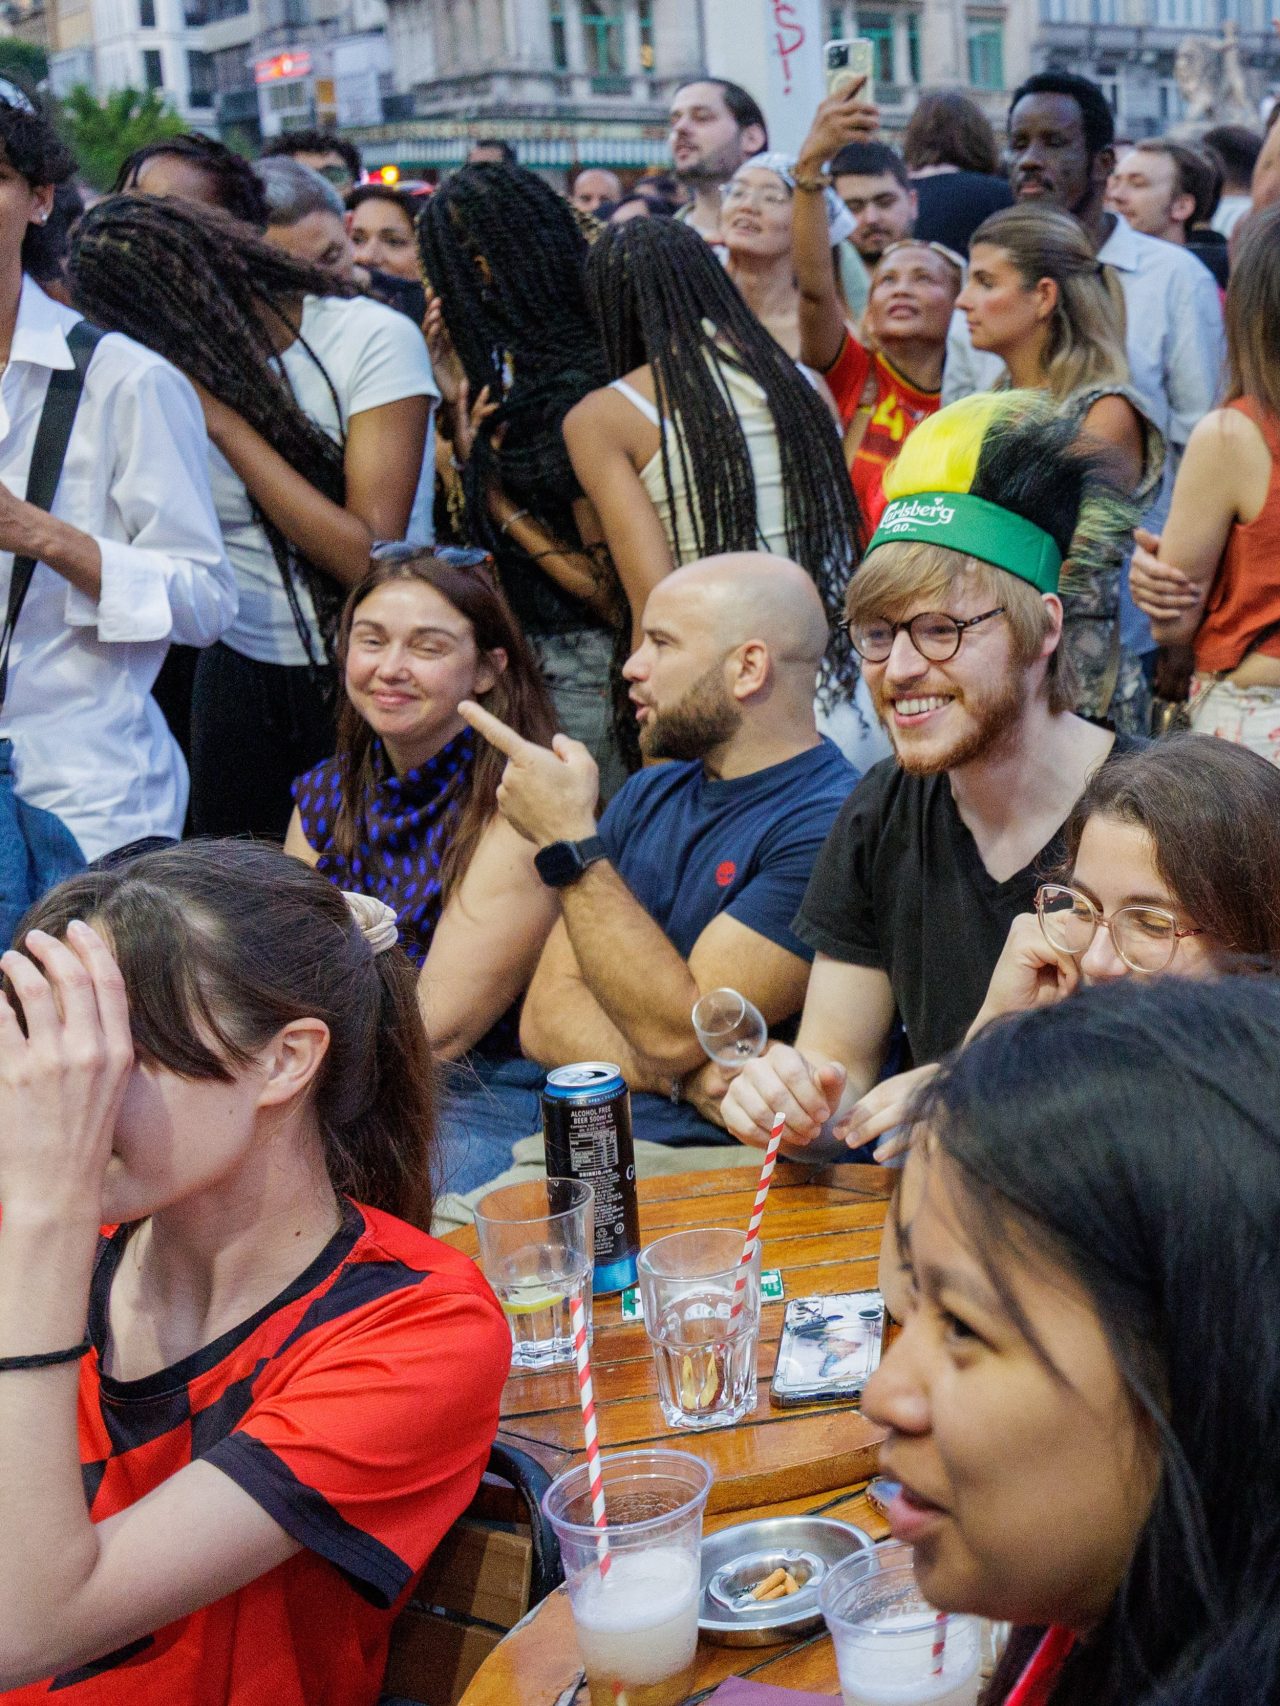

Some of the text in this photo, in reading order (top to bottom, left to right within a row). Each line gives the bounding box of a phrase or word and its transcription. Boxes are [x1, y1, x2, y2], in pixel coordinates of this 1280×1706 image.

[872, 393, 904, 442] 4
[880, 499, 955, 529] Carlsberg
[570, 1105, 611, 1118] ALCOHOL FREE
[573, 1116, 589, 1125] BEER
[626, 1164, 636, 1180] G
